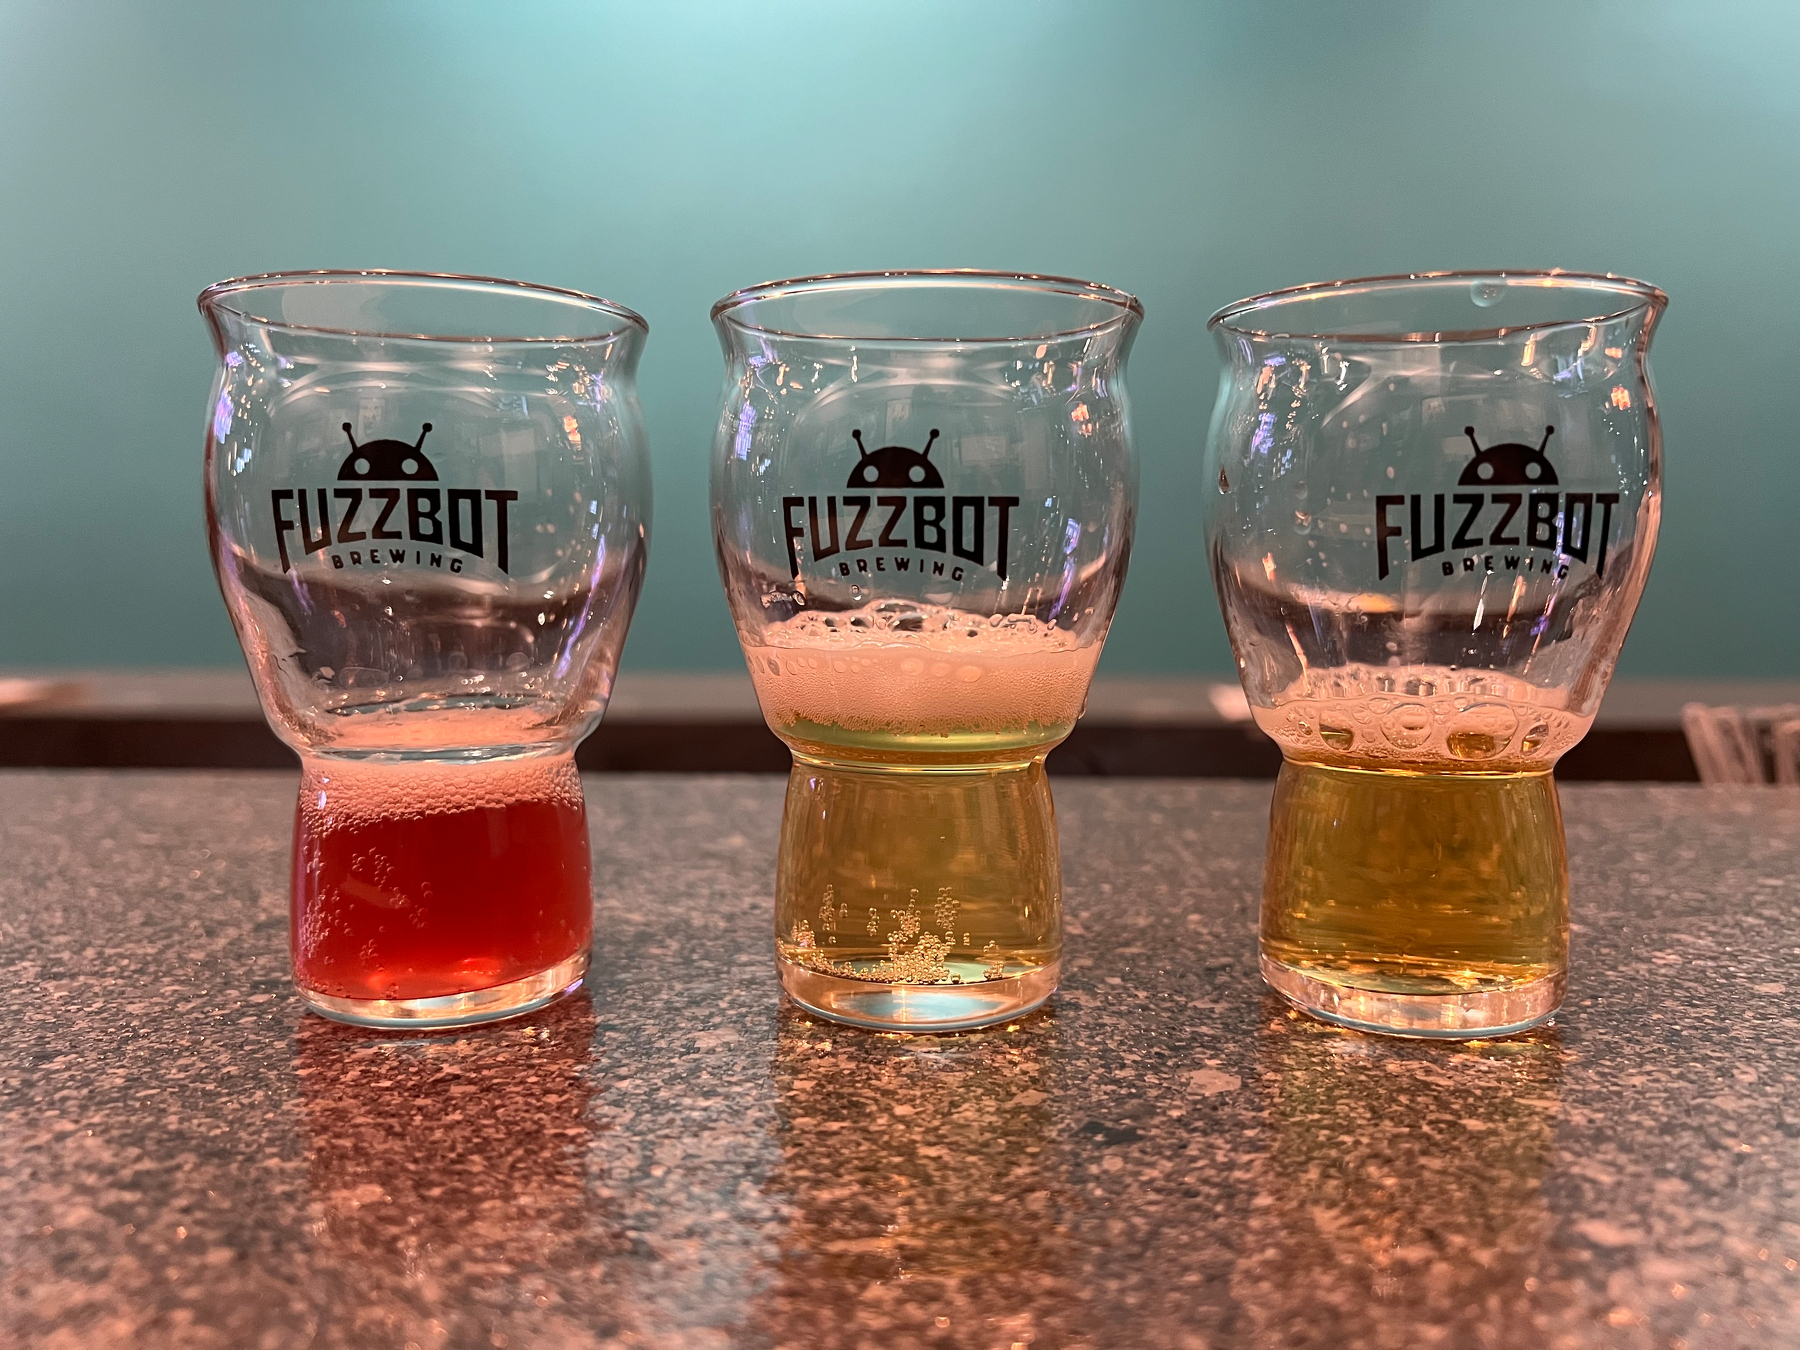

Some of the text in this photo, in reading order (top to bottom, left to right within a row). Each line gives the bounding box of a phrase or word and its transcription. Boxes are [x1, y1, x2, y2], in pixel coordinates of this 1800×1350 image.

[271, 487, 519, 575] FUZZBOT
[782, 495, 1020, 581] FUZZBOT
[1375, 492, 1620, 581] FUZZBOT
[331, 548, 463, 574] BREWING
[838, 556, 964, 582] BREWING
[1441, 554, 1570, 580] BREWING
